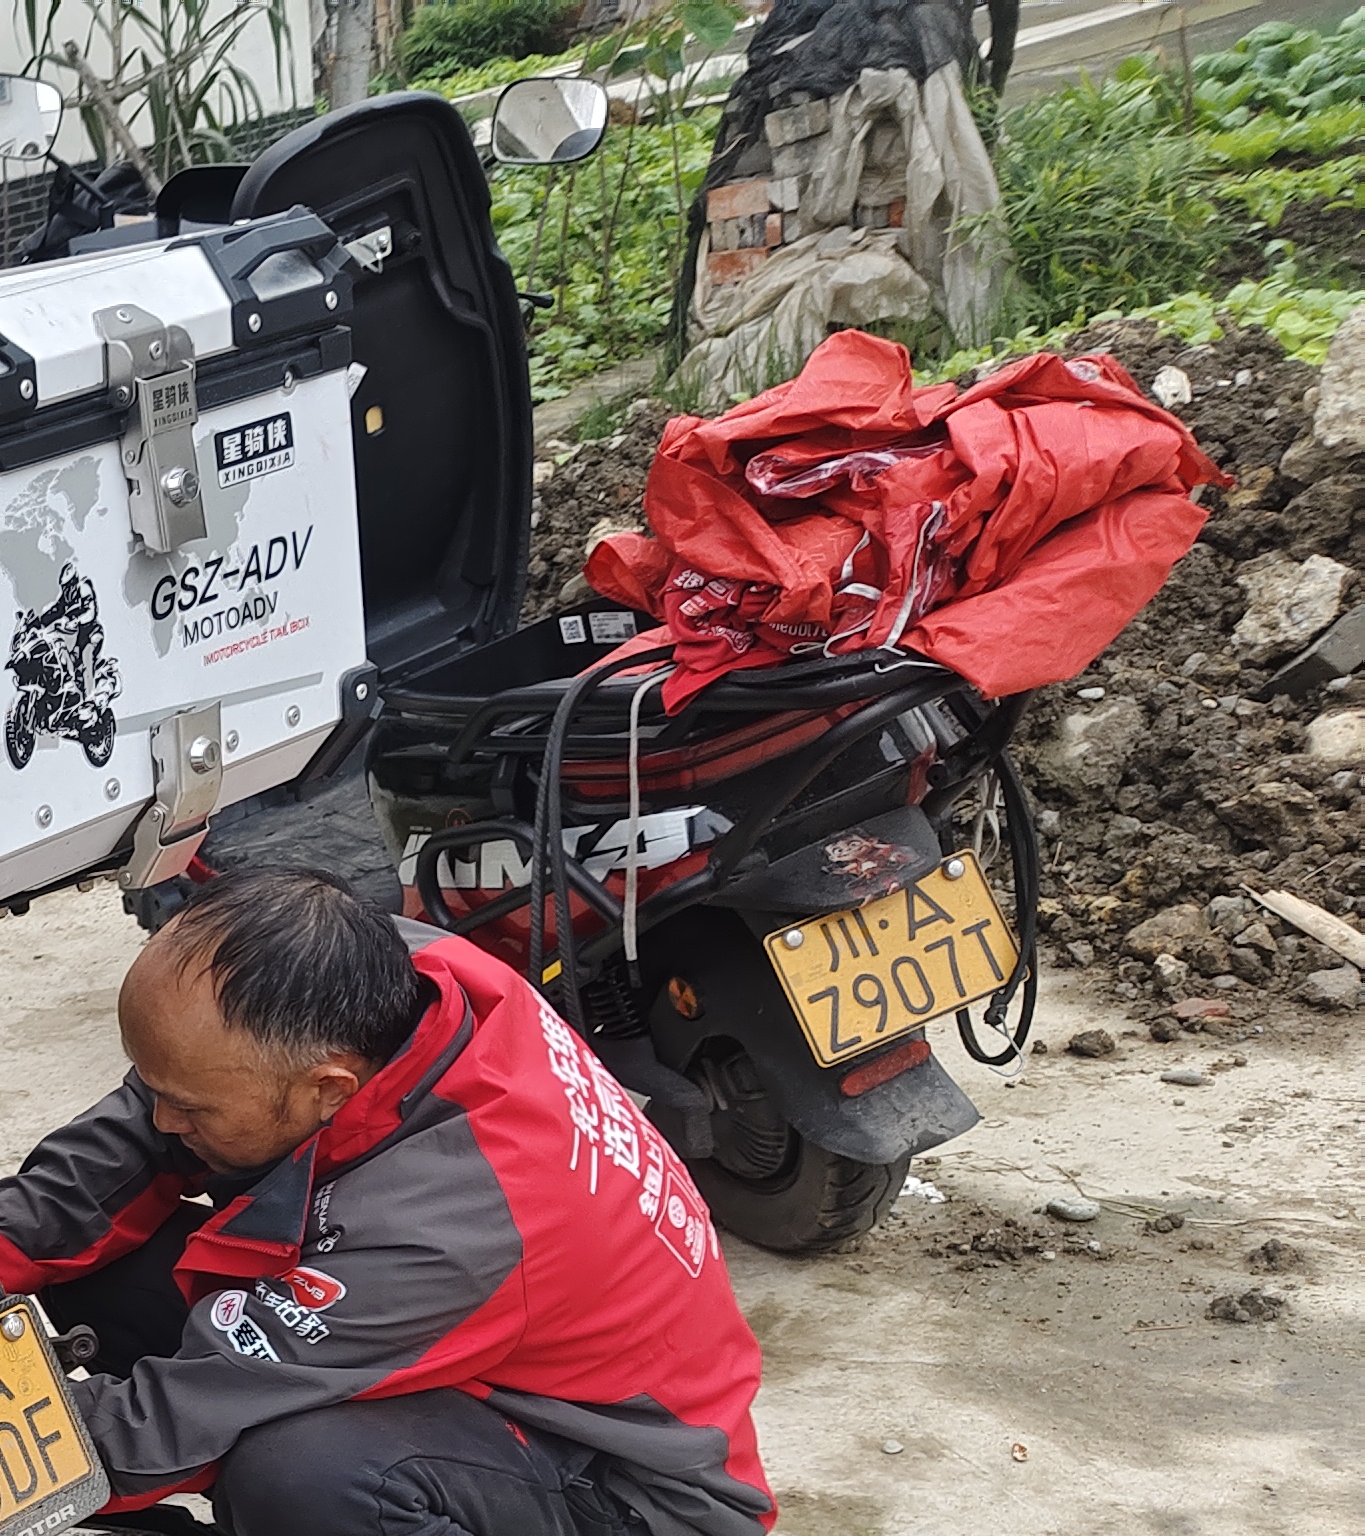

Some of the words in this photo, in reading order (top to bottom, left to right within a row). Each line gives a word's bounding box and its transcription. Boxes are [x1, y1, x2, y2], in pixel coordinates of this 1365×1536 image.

[153, 381, 190, 412] 星骑侠
[222, 418, 287, 464] 星骑侠
[151, 525, 314, 621] GSZ-ADV
[183, 590, 279, 648] MOTOADV
[203, 631, 268, 667] MOTORCYCLE
[269, 624, 288, 641] TAIL
[289, 616, 310, 634] BOX
[808, 919, 1004, 1053] Z907T
[531, 990, 599, 1195] 二轮车维
